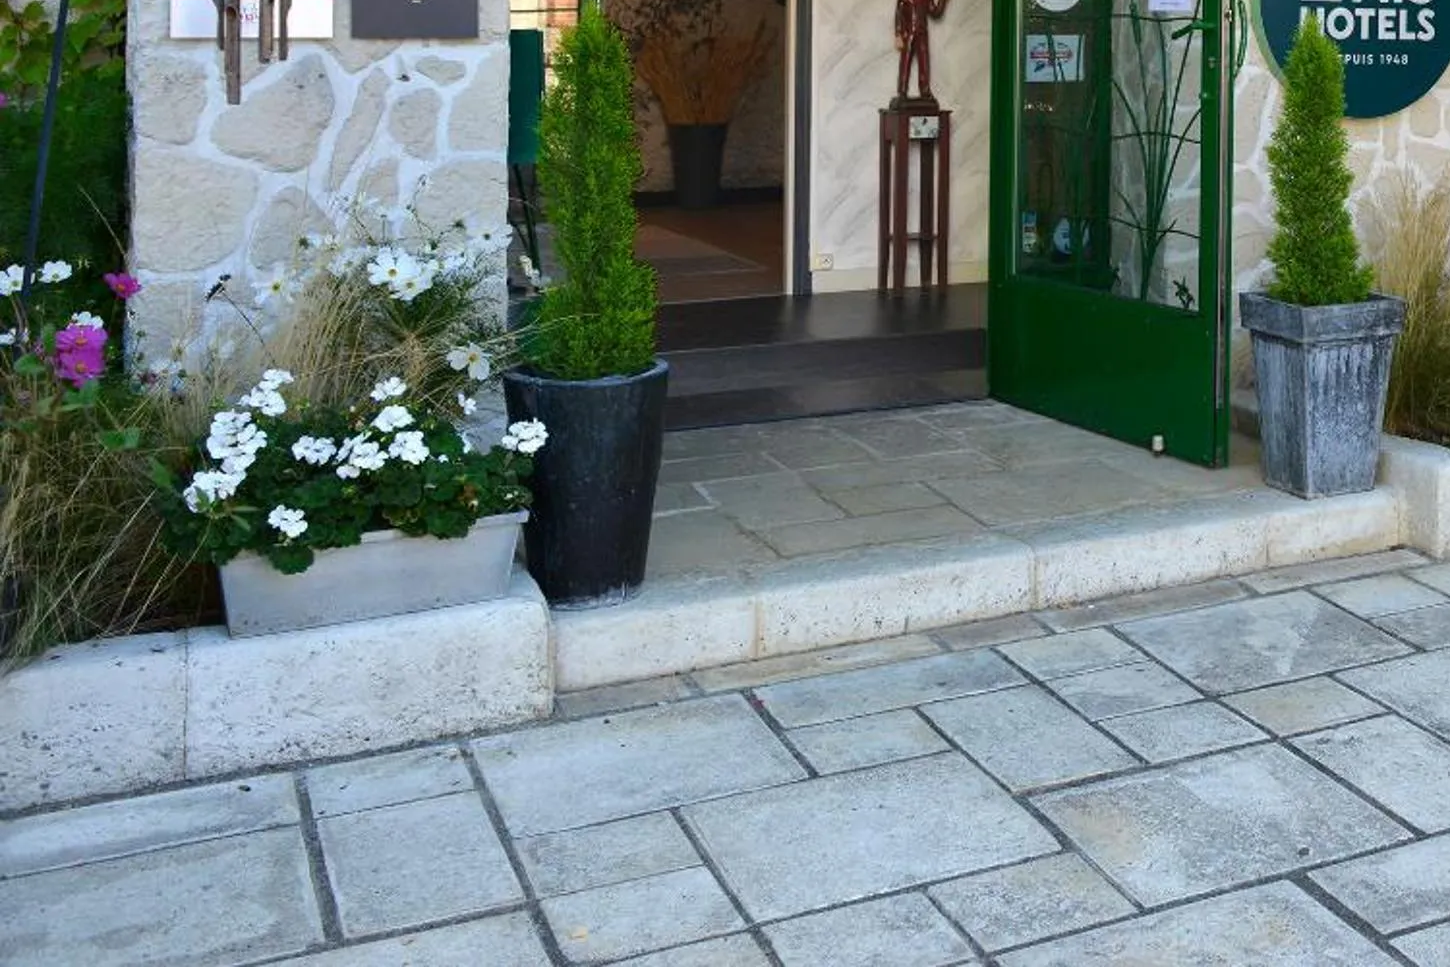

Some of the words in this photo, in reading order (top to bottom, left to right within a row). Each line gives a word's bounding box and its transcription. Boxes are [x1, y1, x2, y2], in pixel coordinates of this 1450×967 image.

[1300, 6, 1436, 42] HOTELS
[1337, 53, 1375, 66] PUIS
[1379, 54, 1409, 66] 1948
